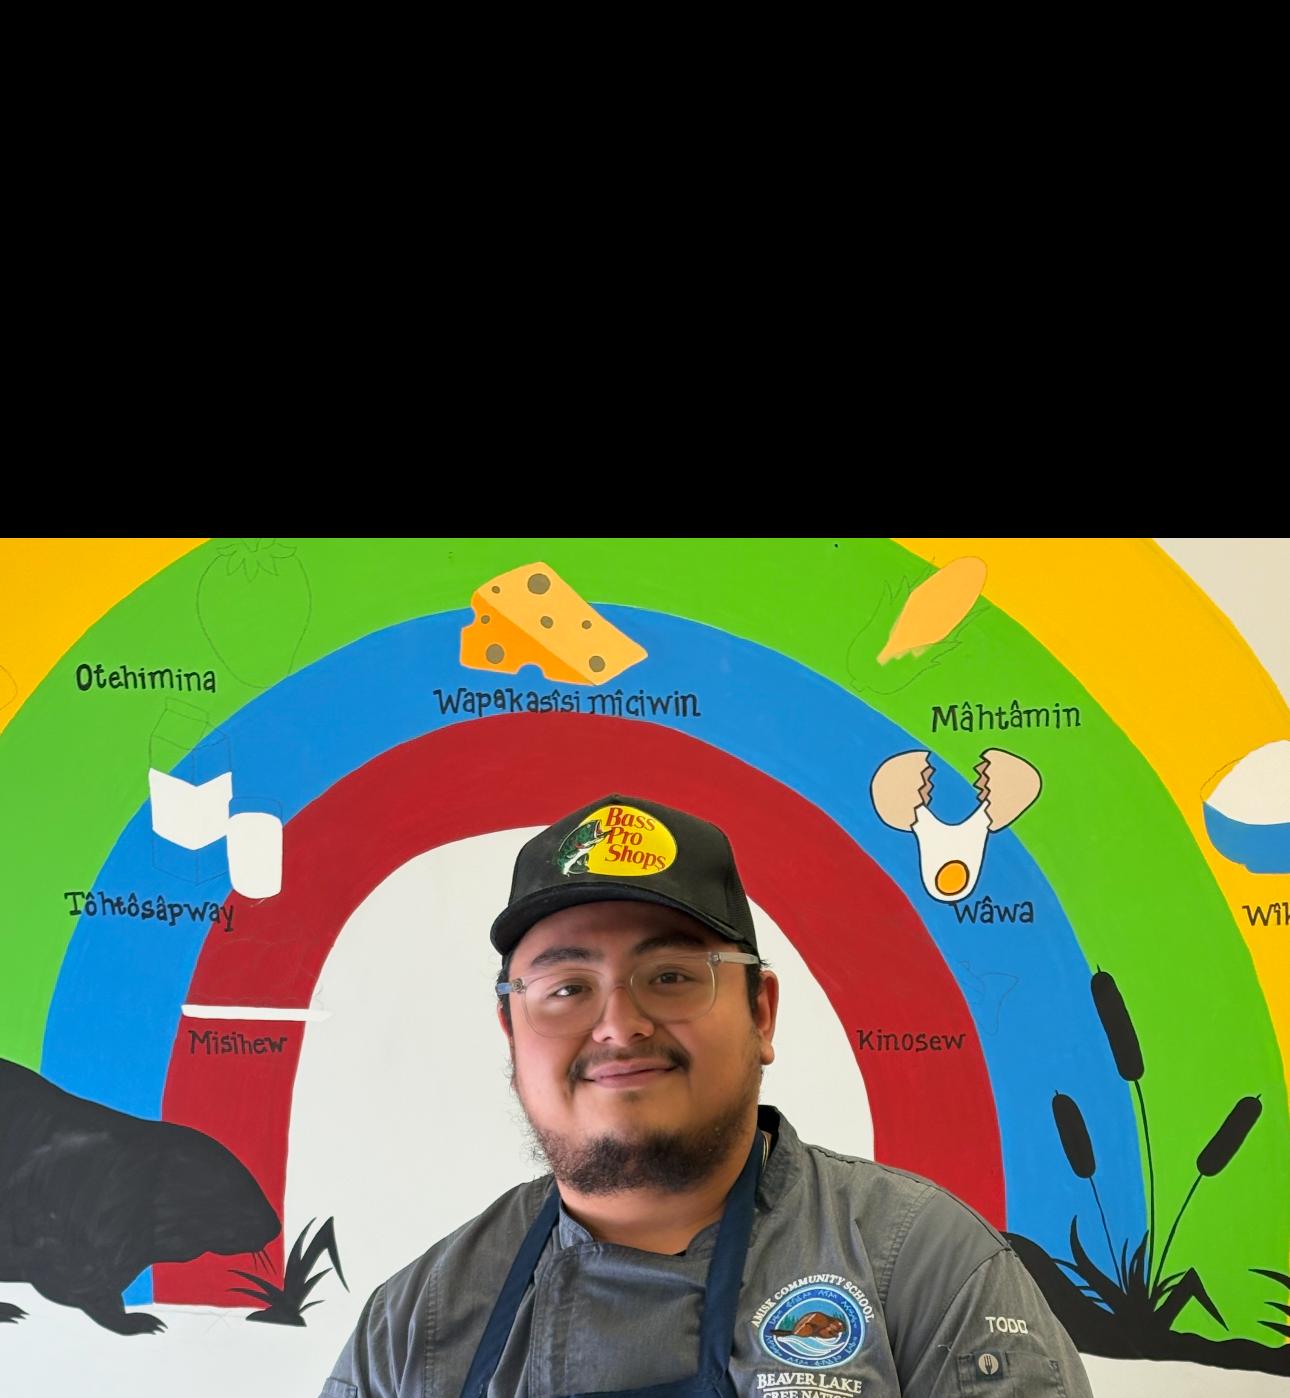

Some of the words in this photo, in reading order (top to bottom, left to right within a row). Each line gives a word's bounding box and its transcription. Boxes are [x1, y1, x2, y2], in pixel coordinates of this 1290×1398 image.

[75, 663, 216, 693] Otehimina
[587, 688, 701, 718] mîciwin
[931, 699, 1081, 733] Mâhtâmin
[605, 807, 656, 831] Bass
[605, 826, 643, 846] Pro
[605, 843, 666, 872] Shops
[64, 891, 234, 932] Tôhtôsâpway
[188, 1030, 288, 1055] Misihew
[856, 1029, 966, 1053] Kinosew
[751, 1297, 777, 1328] AMISK
[774, 1273, 846, 1300] COMMUNITY
[843, 1281, 875, 1323] SCHOOL
[984, 1316, 1029, 1335] TODD
[757, 1372, 817, 1390] BEAVER
[819, 1373, 862, 1394] LAKE
